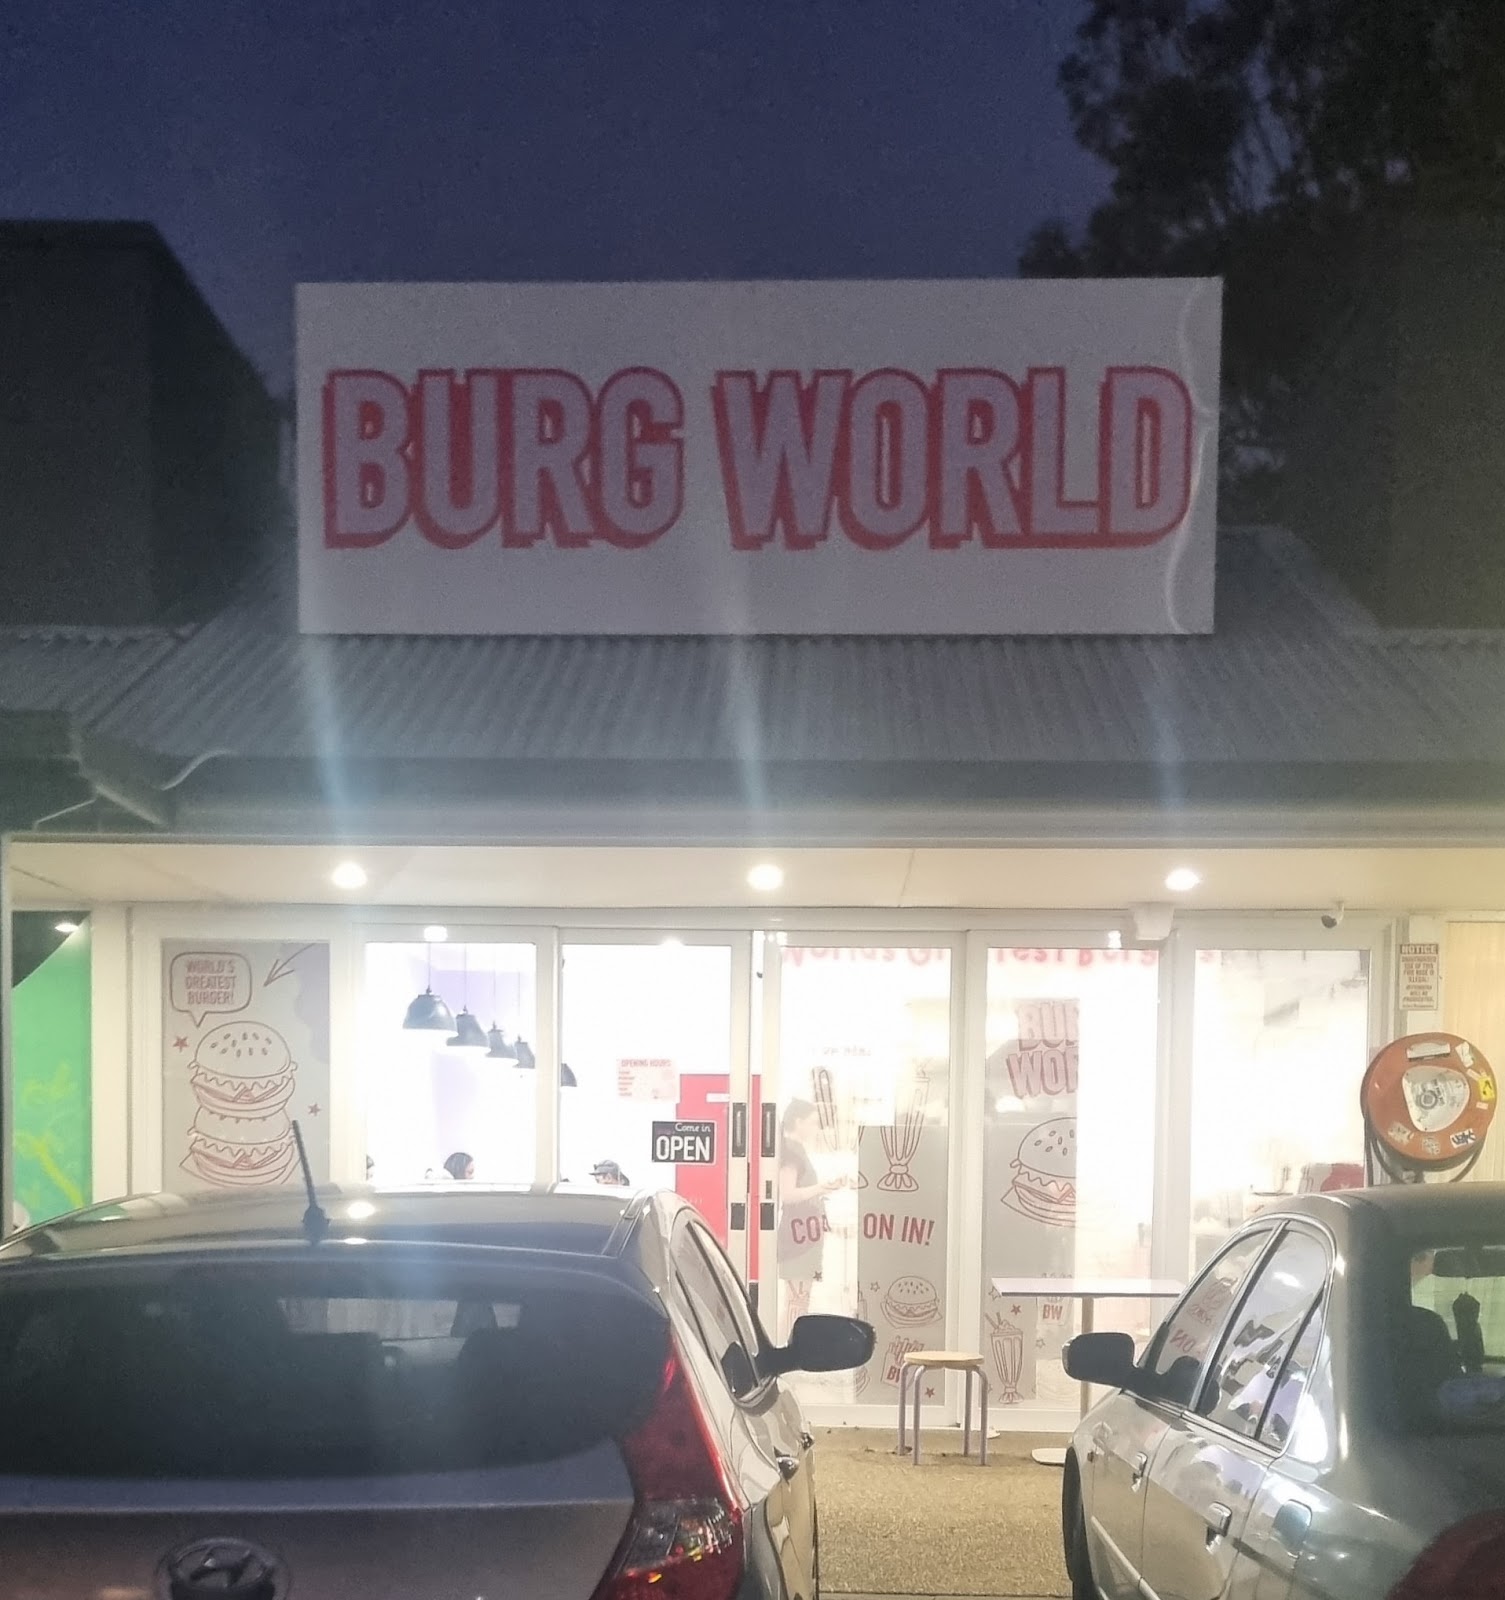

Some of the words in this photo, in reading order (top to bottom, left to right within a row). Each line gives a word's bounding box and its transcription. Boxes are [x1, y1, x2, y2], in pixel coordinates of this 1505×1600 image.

[322, 366, 685, 550] BURG
[711, 366, 1194, 551] WORLD
[1401, 944, 1437, 954] NOTICE
[185, 975, 237, 989] GREATEST
[187, 990, 235, 1004] BURGER!
[621, 1059, 648, 1067] OPENING
[649, 1059, 672, 1067] HOURS
[674, 1122, 699, 1133] Come
[701, 1123, 711, 1133] in
[656, 1135, 711, 1161] OPEN
[863, 1213, 895, 1241] ON
[901, 1215, 935, 1246] IN!
[1043, 1304, 1063, 1320] BW
